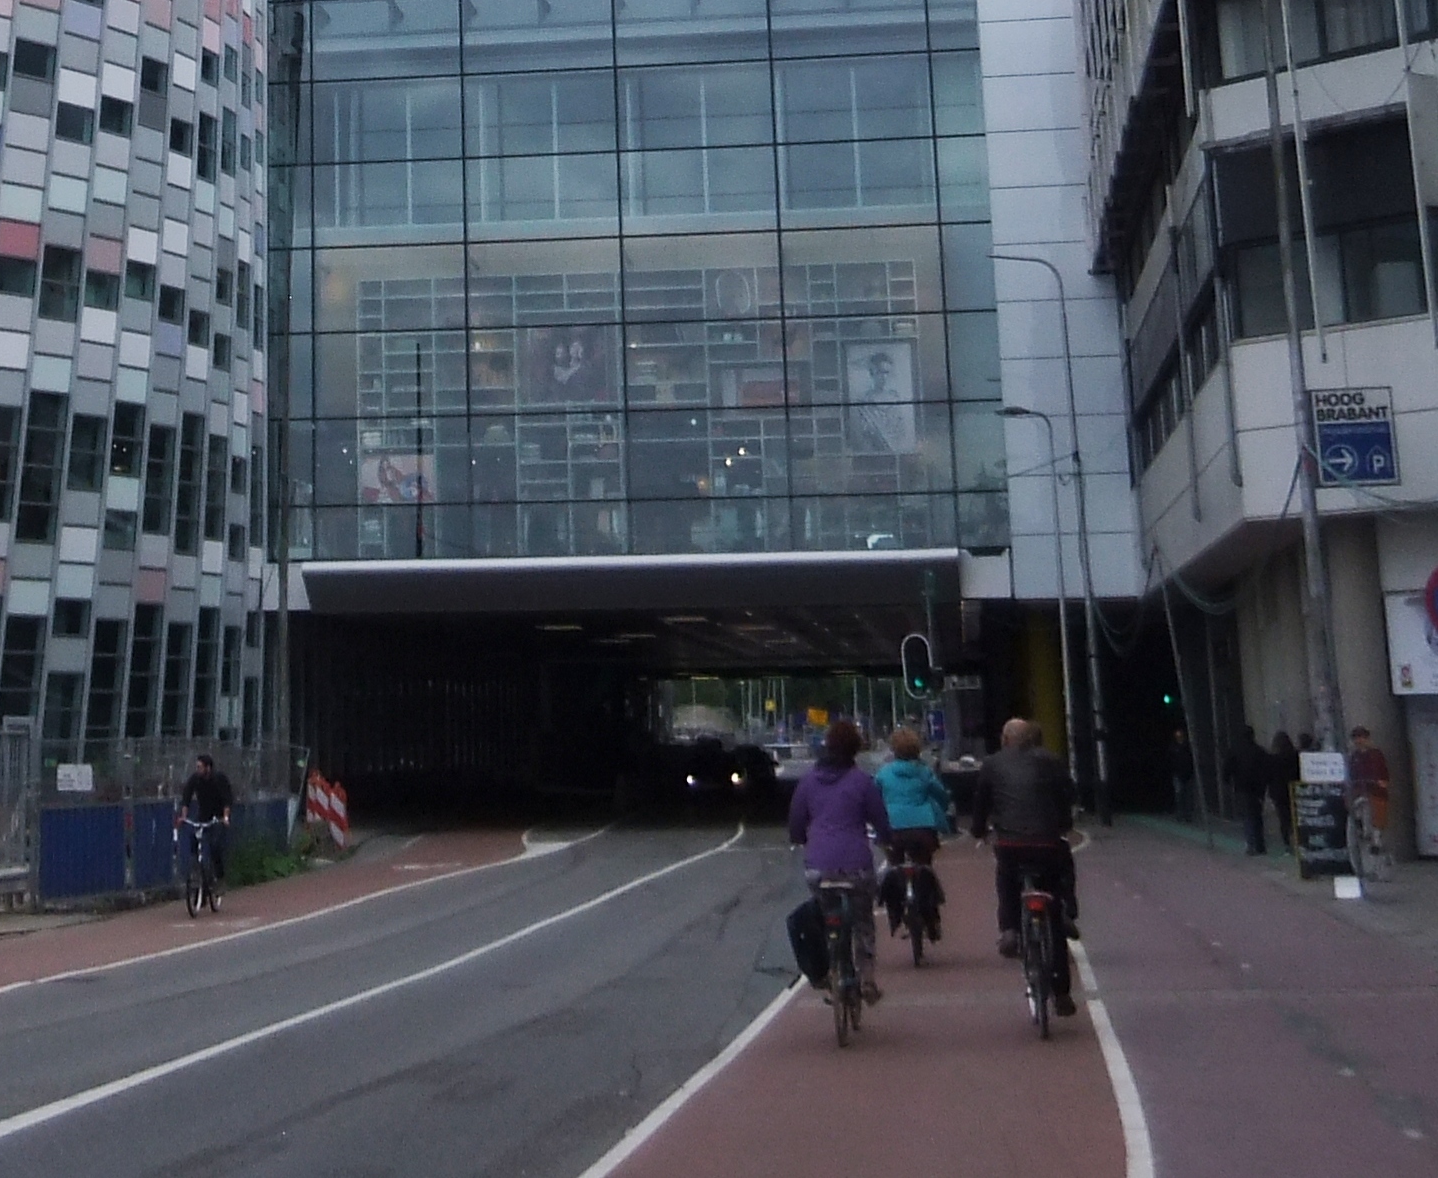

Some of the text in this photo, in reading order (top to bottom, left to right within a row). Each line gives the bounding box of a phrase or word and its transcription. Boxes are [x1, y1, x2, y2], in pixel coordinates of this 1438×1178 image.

[1315, 393, 1364, 406] HOOG
[1316, 406, 1388, 422] BRABANT
[1373, 455, 1384, 474] P
